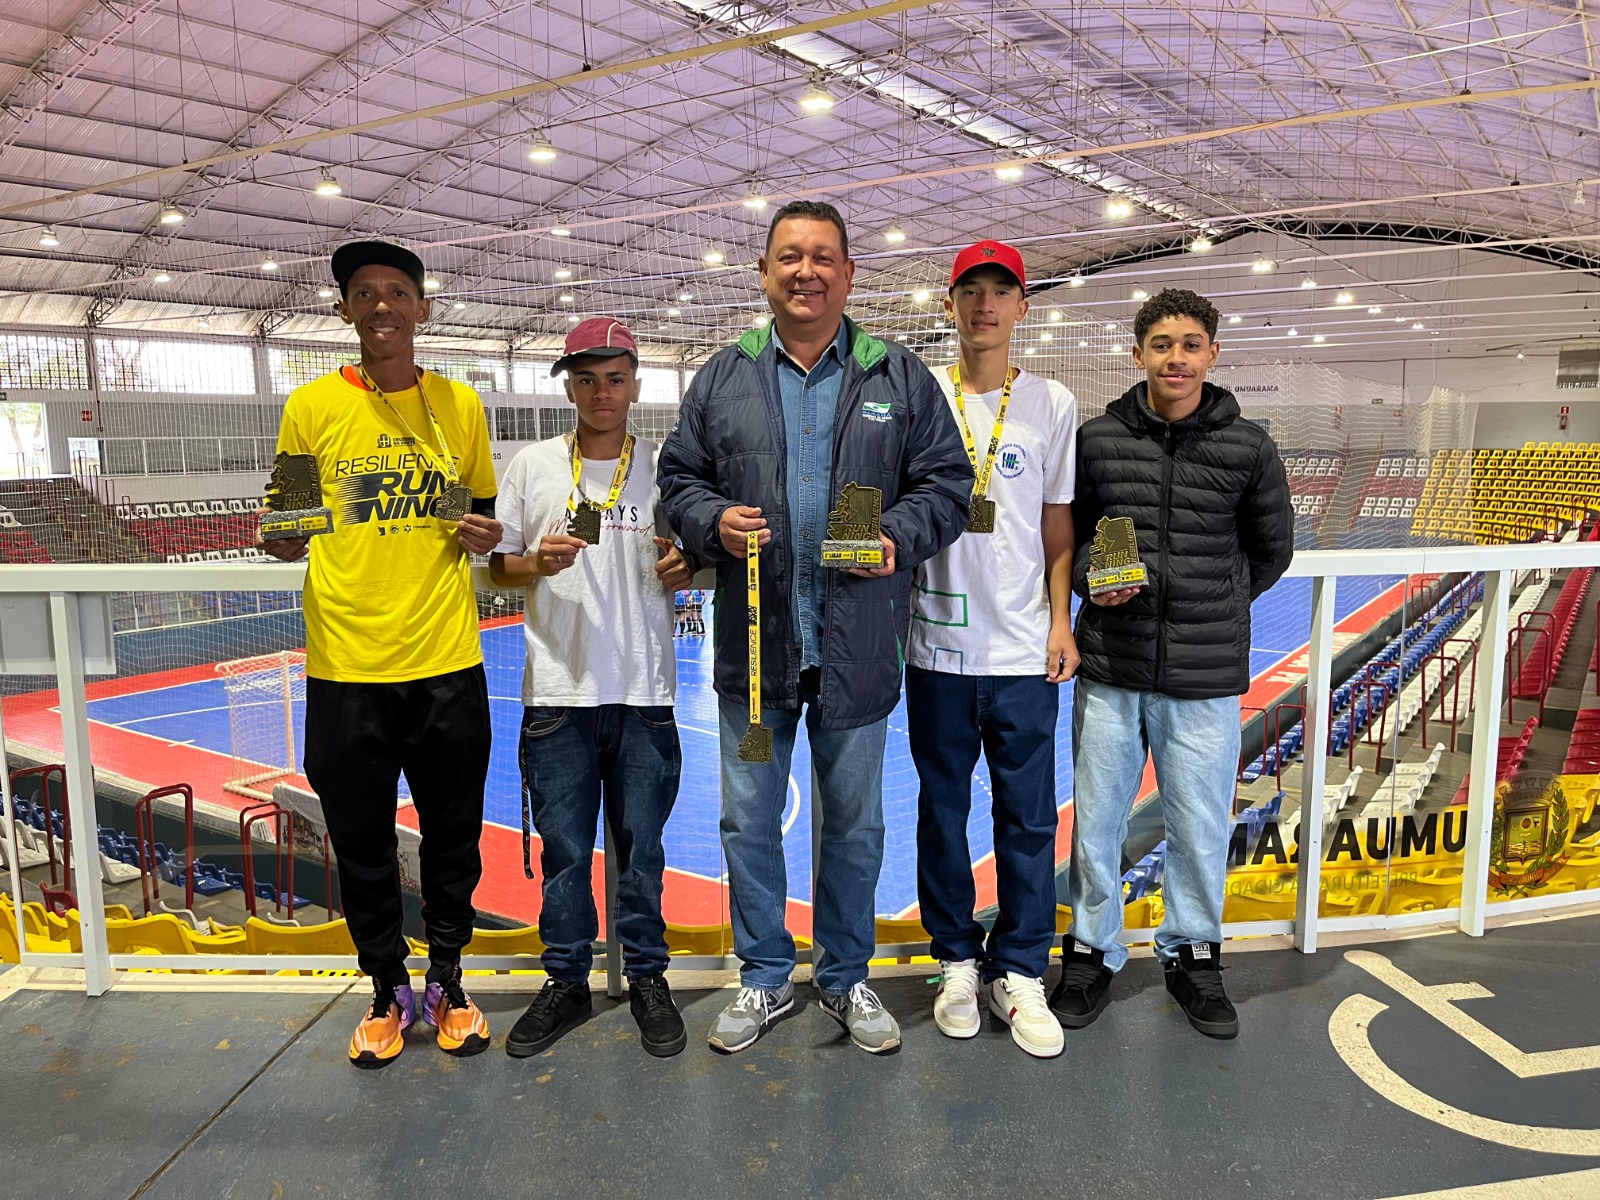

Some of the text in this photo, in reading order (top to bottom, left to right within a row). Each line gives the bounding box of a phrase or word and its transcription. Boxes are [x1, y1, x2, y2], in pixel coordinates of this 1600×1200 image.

[335, 453, 460, 477] RESILIEN
[978, 458, 993, 496] ESILIENCE
[285, 492, 310, 503] RUN
[283, 500, 314, 511] NING
[565, 505, 638, 522] AAYS
[871, 490, 880, 540] RESILIENCE
[845, 525, 869, 533] RUN
[842, 532, 872, 540] NING
[1106, 551, 1129, 561] RUN
[1105, 557, 1131, 569] NING
